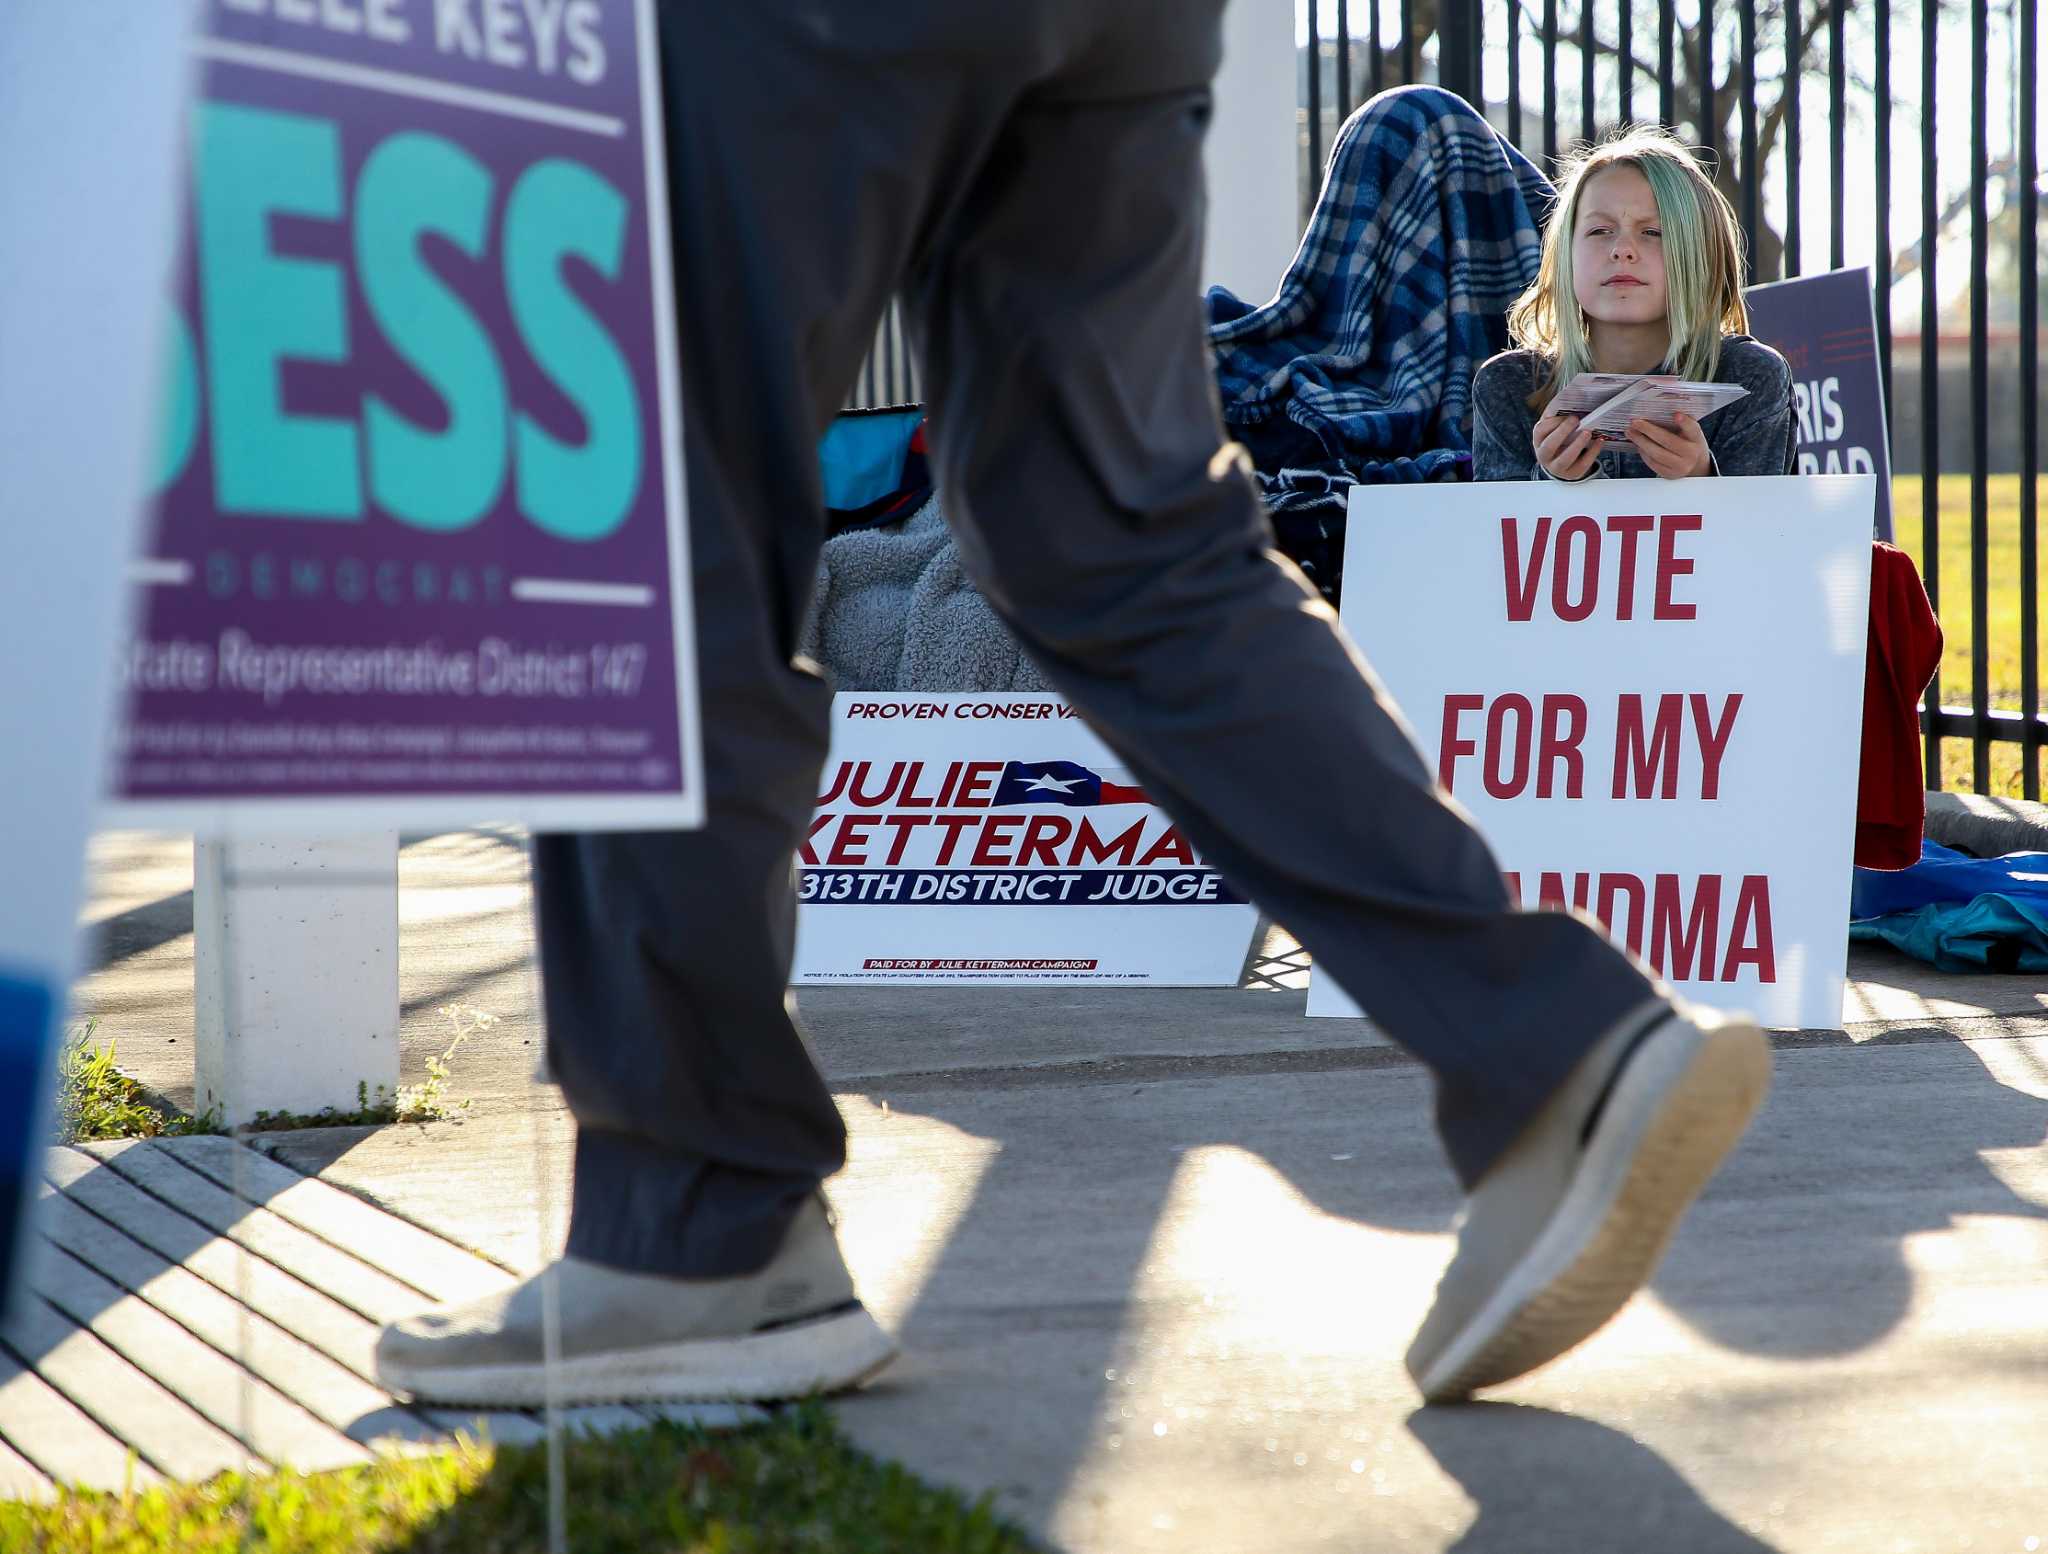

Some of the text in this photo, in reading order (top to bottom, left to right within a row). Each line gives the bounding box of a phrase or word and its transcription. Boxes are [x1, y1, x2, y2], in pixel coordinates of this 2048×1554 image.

[436, 0, 606, 84] KEYS
[150, 102, 642, 542] ESS
[1501, 515, 1702, 622] VOTE
[117, 636, 213, 691] tate
[847, 703, 949, 719] PROVEN
[1438, 693, 1743, 800] FOR MY
[815, 761, 1005, 807] JULIE
[801, 814, 1212, 867] KETTERMA
[799, 874, 1223, 900] 313TH DISTRICT JUDGE
[870, 961, 1090, 969] PAID FOR BY JULIE KETTERMAN CAMPAIGN
